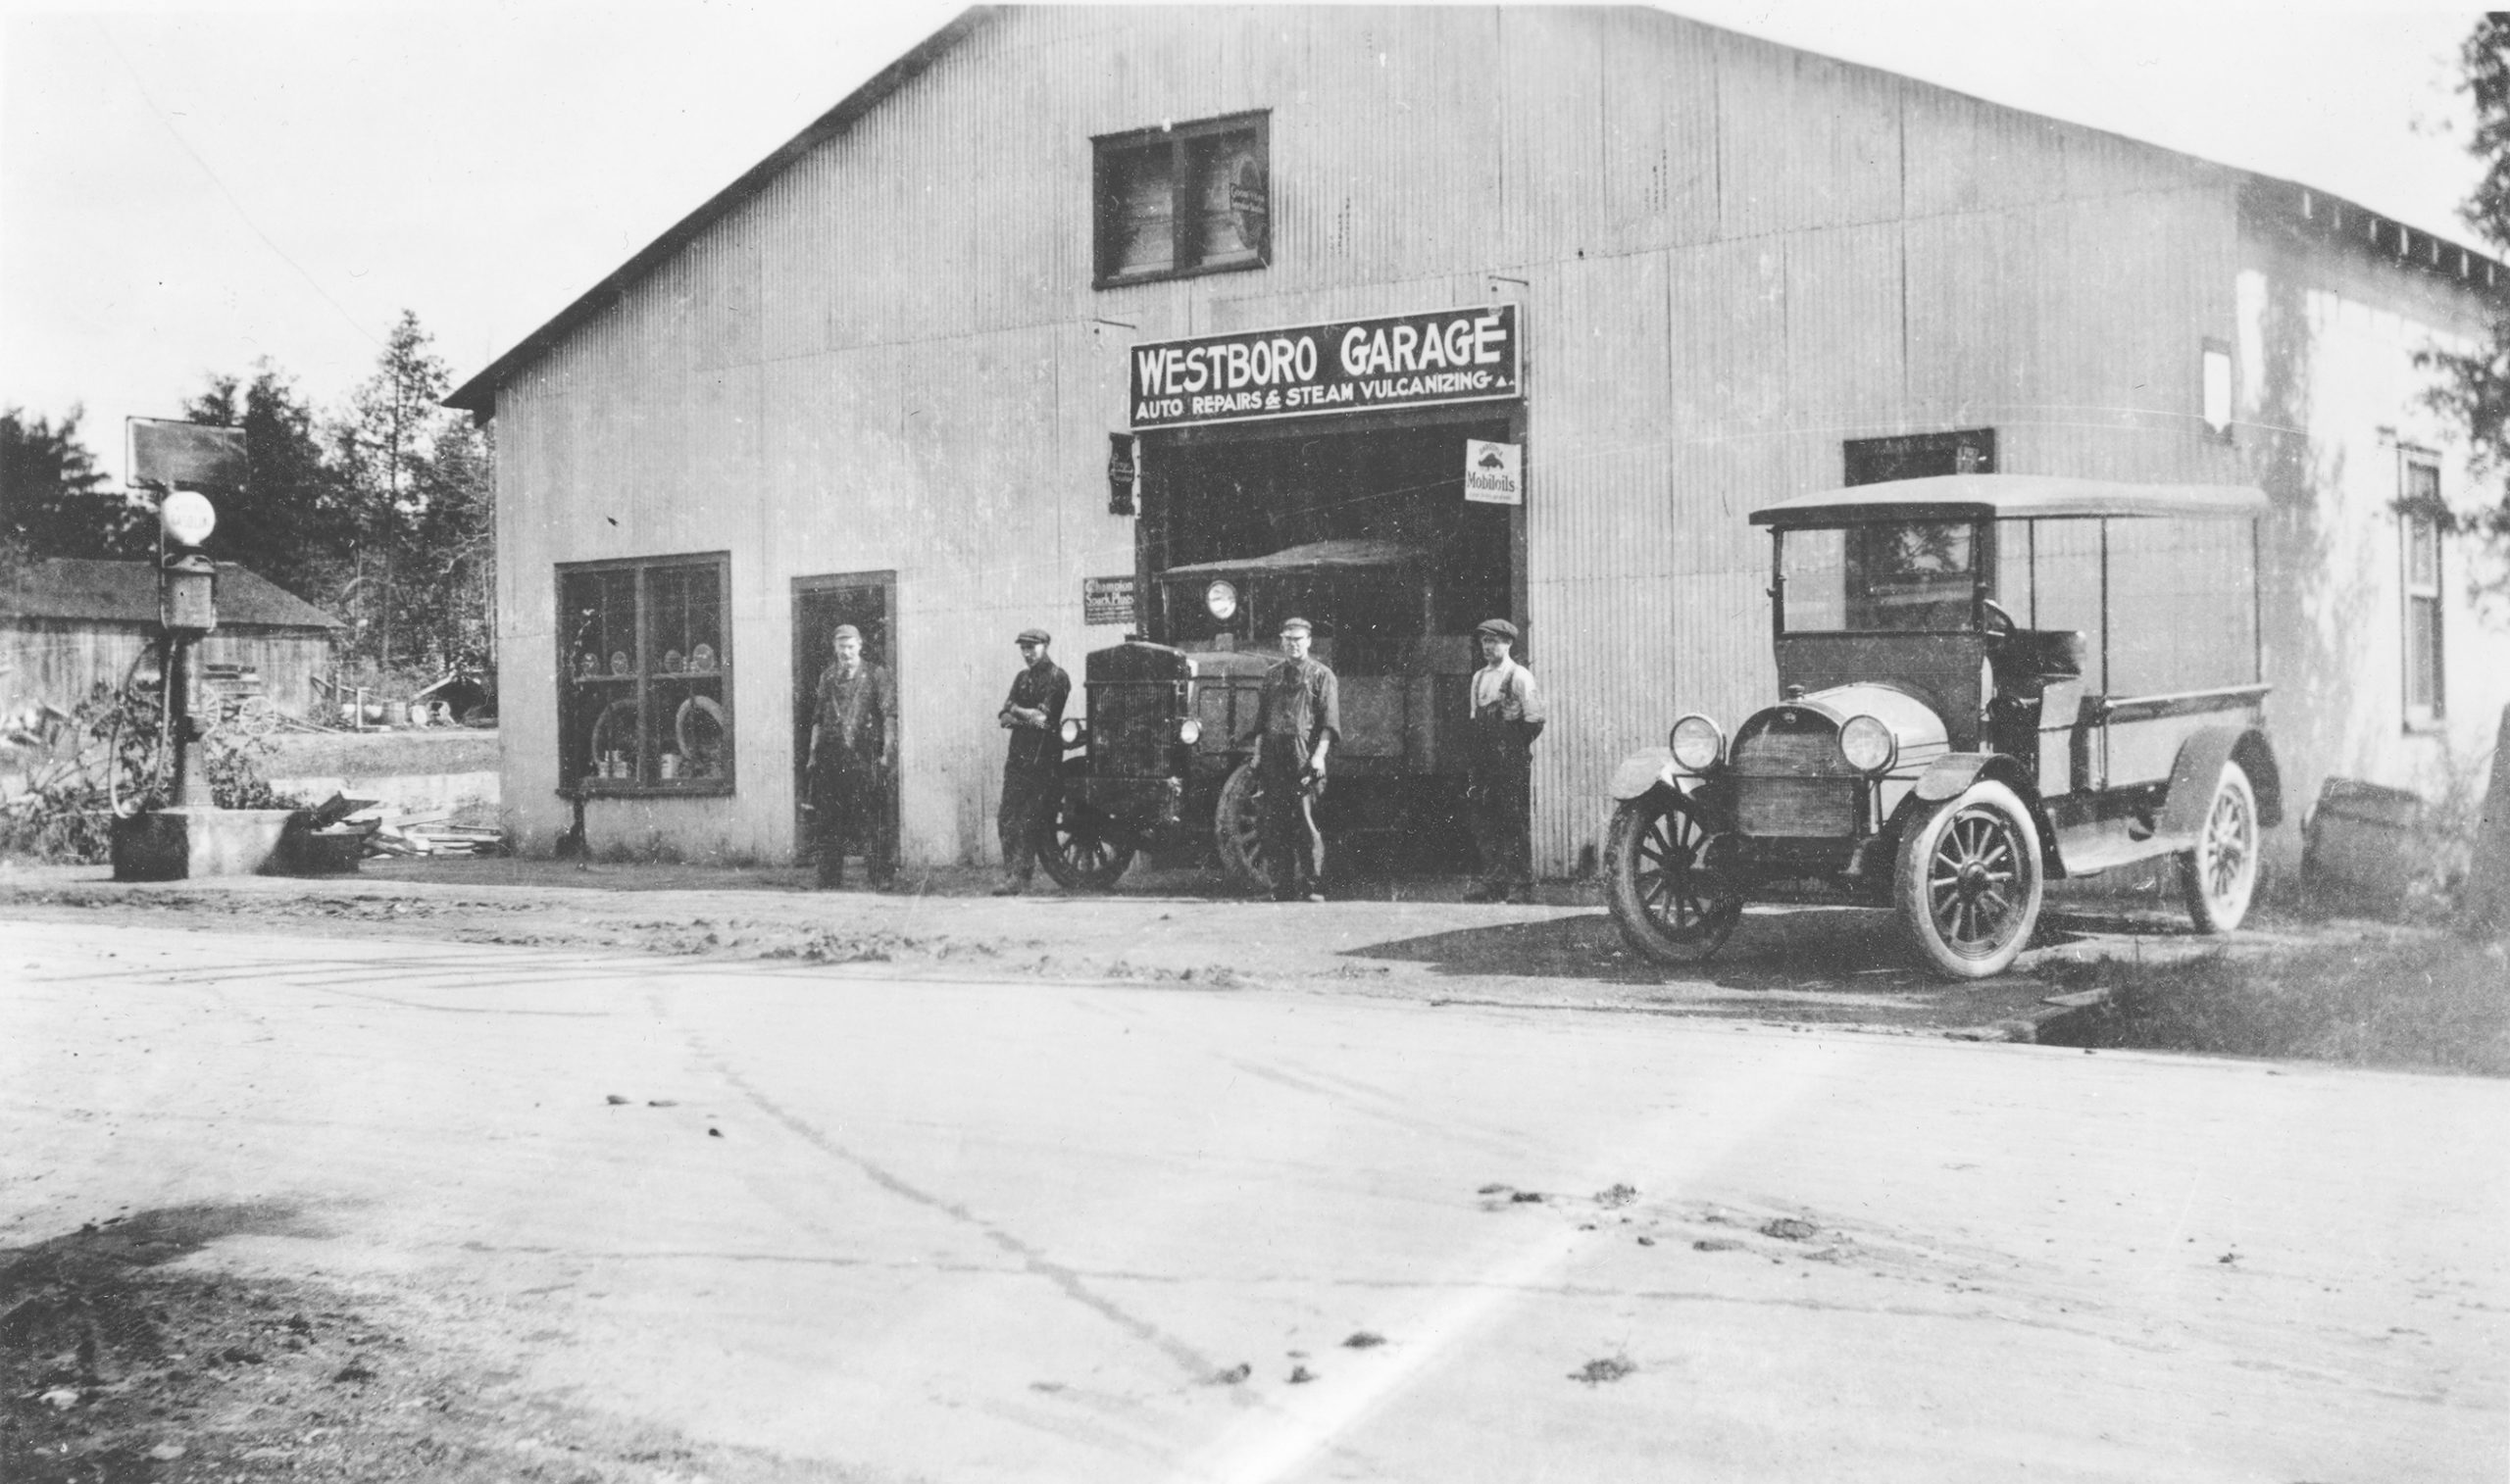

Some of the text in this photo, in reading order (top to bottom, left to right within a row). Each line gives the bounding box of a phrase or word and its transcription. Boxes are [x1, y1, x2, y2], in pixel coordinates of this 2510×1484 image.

[1137, 316, 1507, 397] WESTBORO GARAGE
[1135, 371, 1493, 420] AUTO REPAIRS & STEAM VULCANIZING
[1467, 470, 1516, 493] Mobiloils
